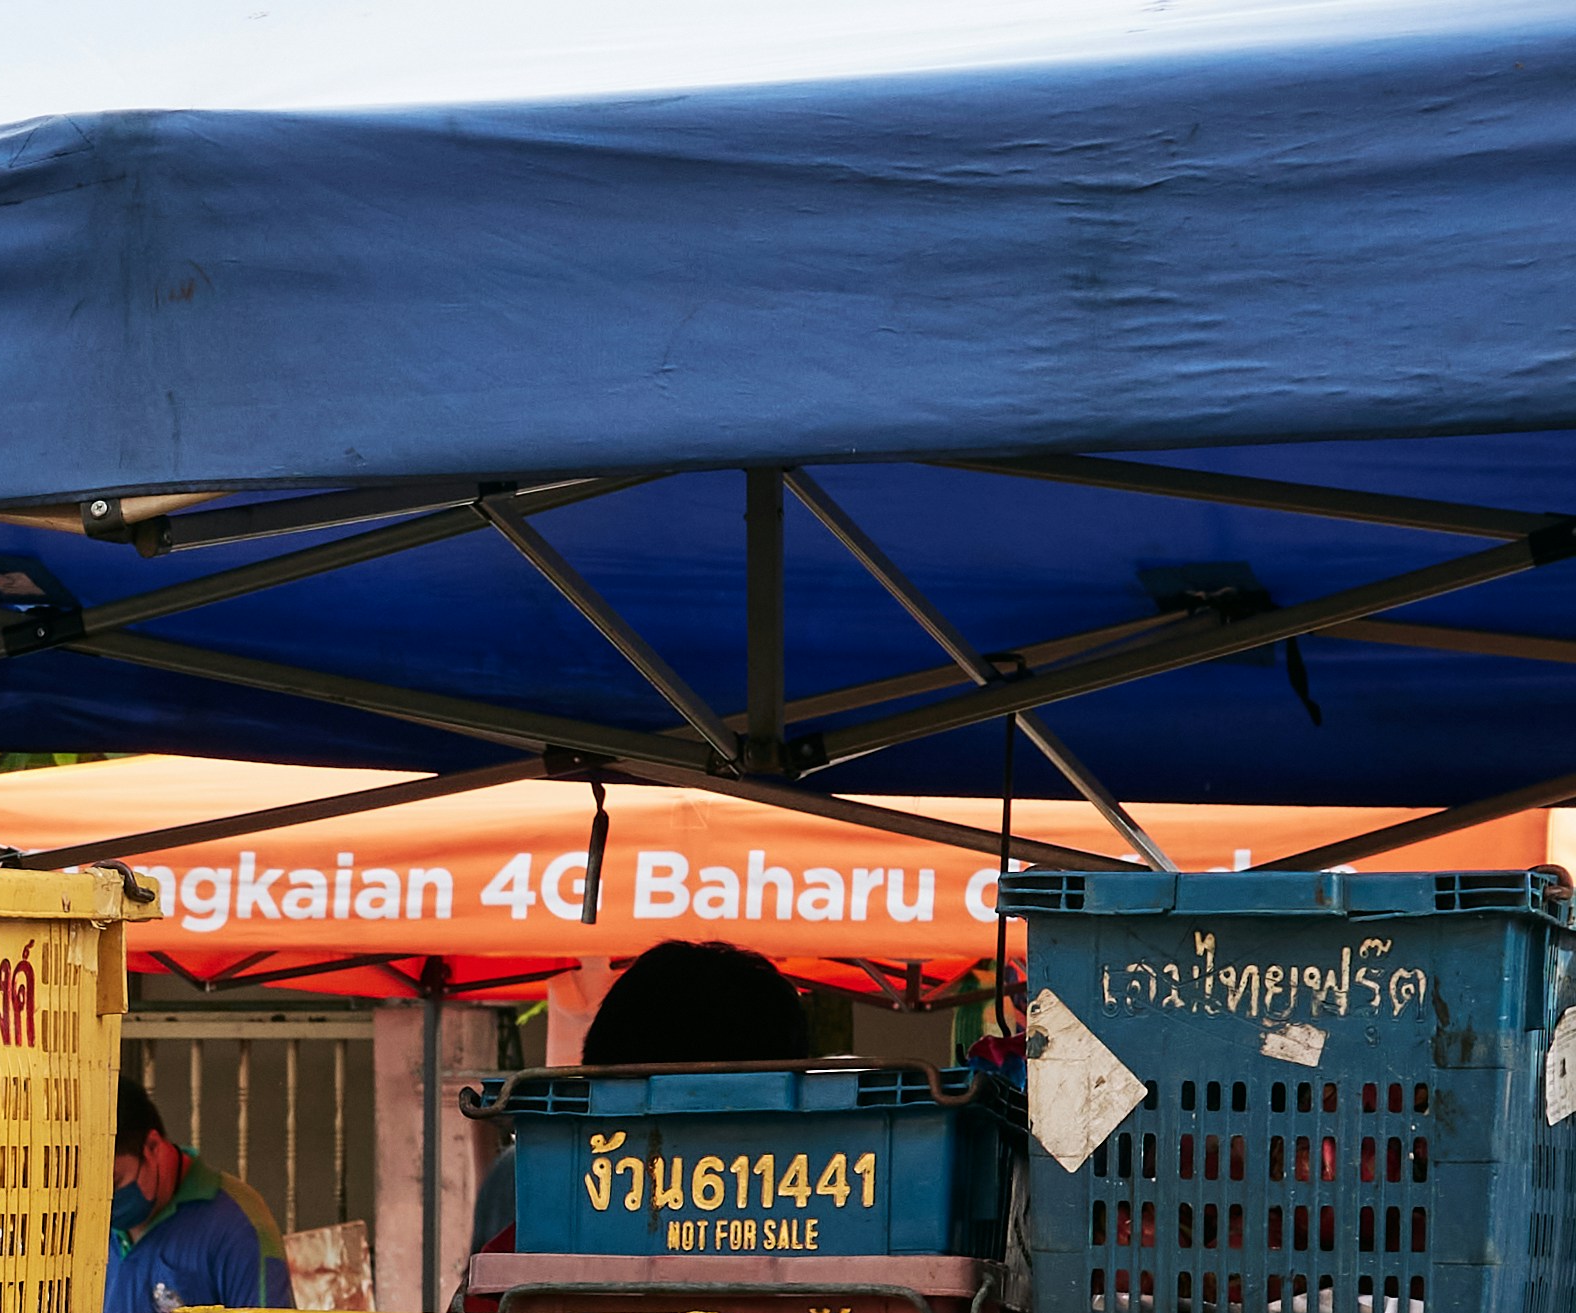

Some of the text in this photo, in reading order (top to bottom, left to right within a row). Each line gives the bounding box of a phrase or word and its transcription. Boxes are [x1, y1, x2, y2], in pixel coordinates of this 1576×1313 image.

[635, 850, 936, 923] Baharu
[667, 1219, 819, 1251] NOT FOR SALE
